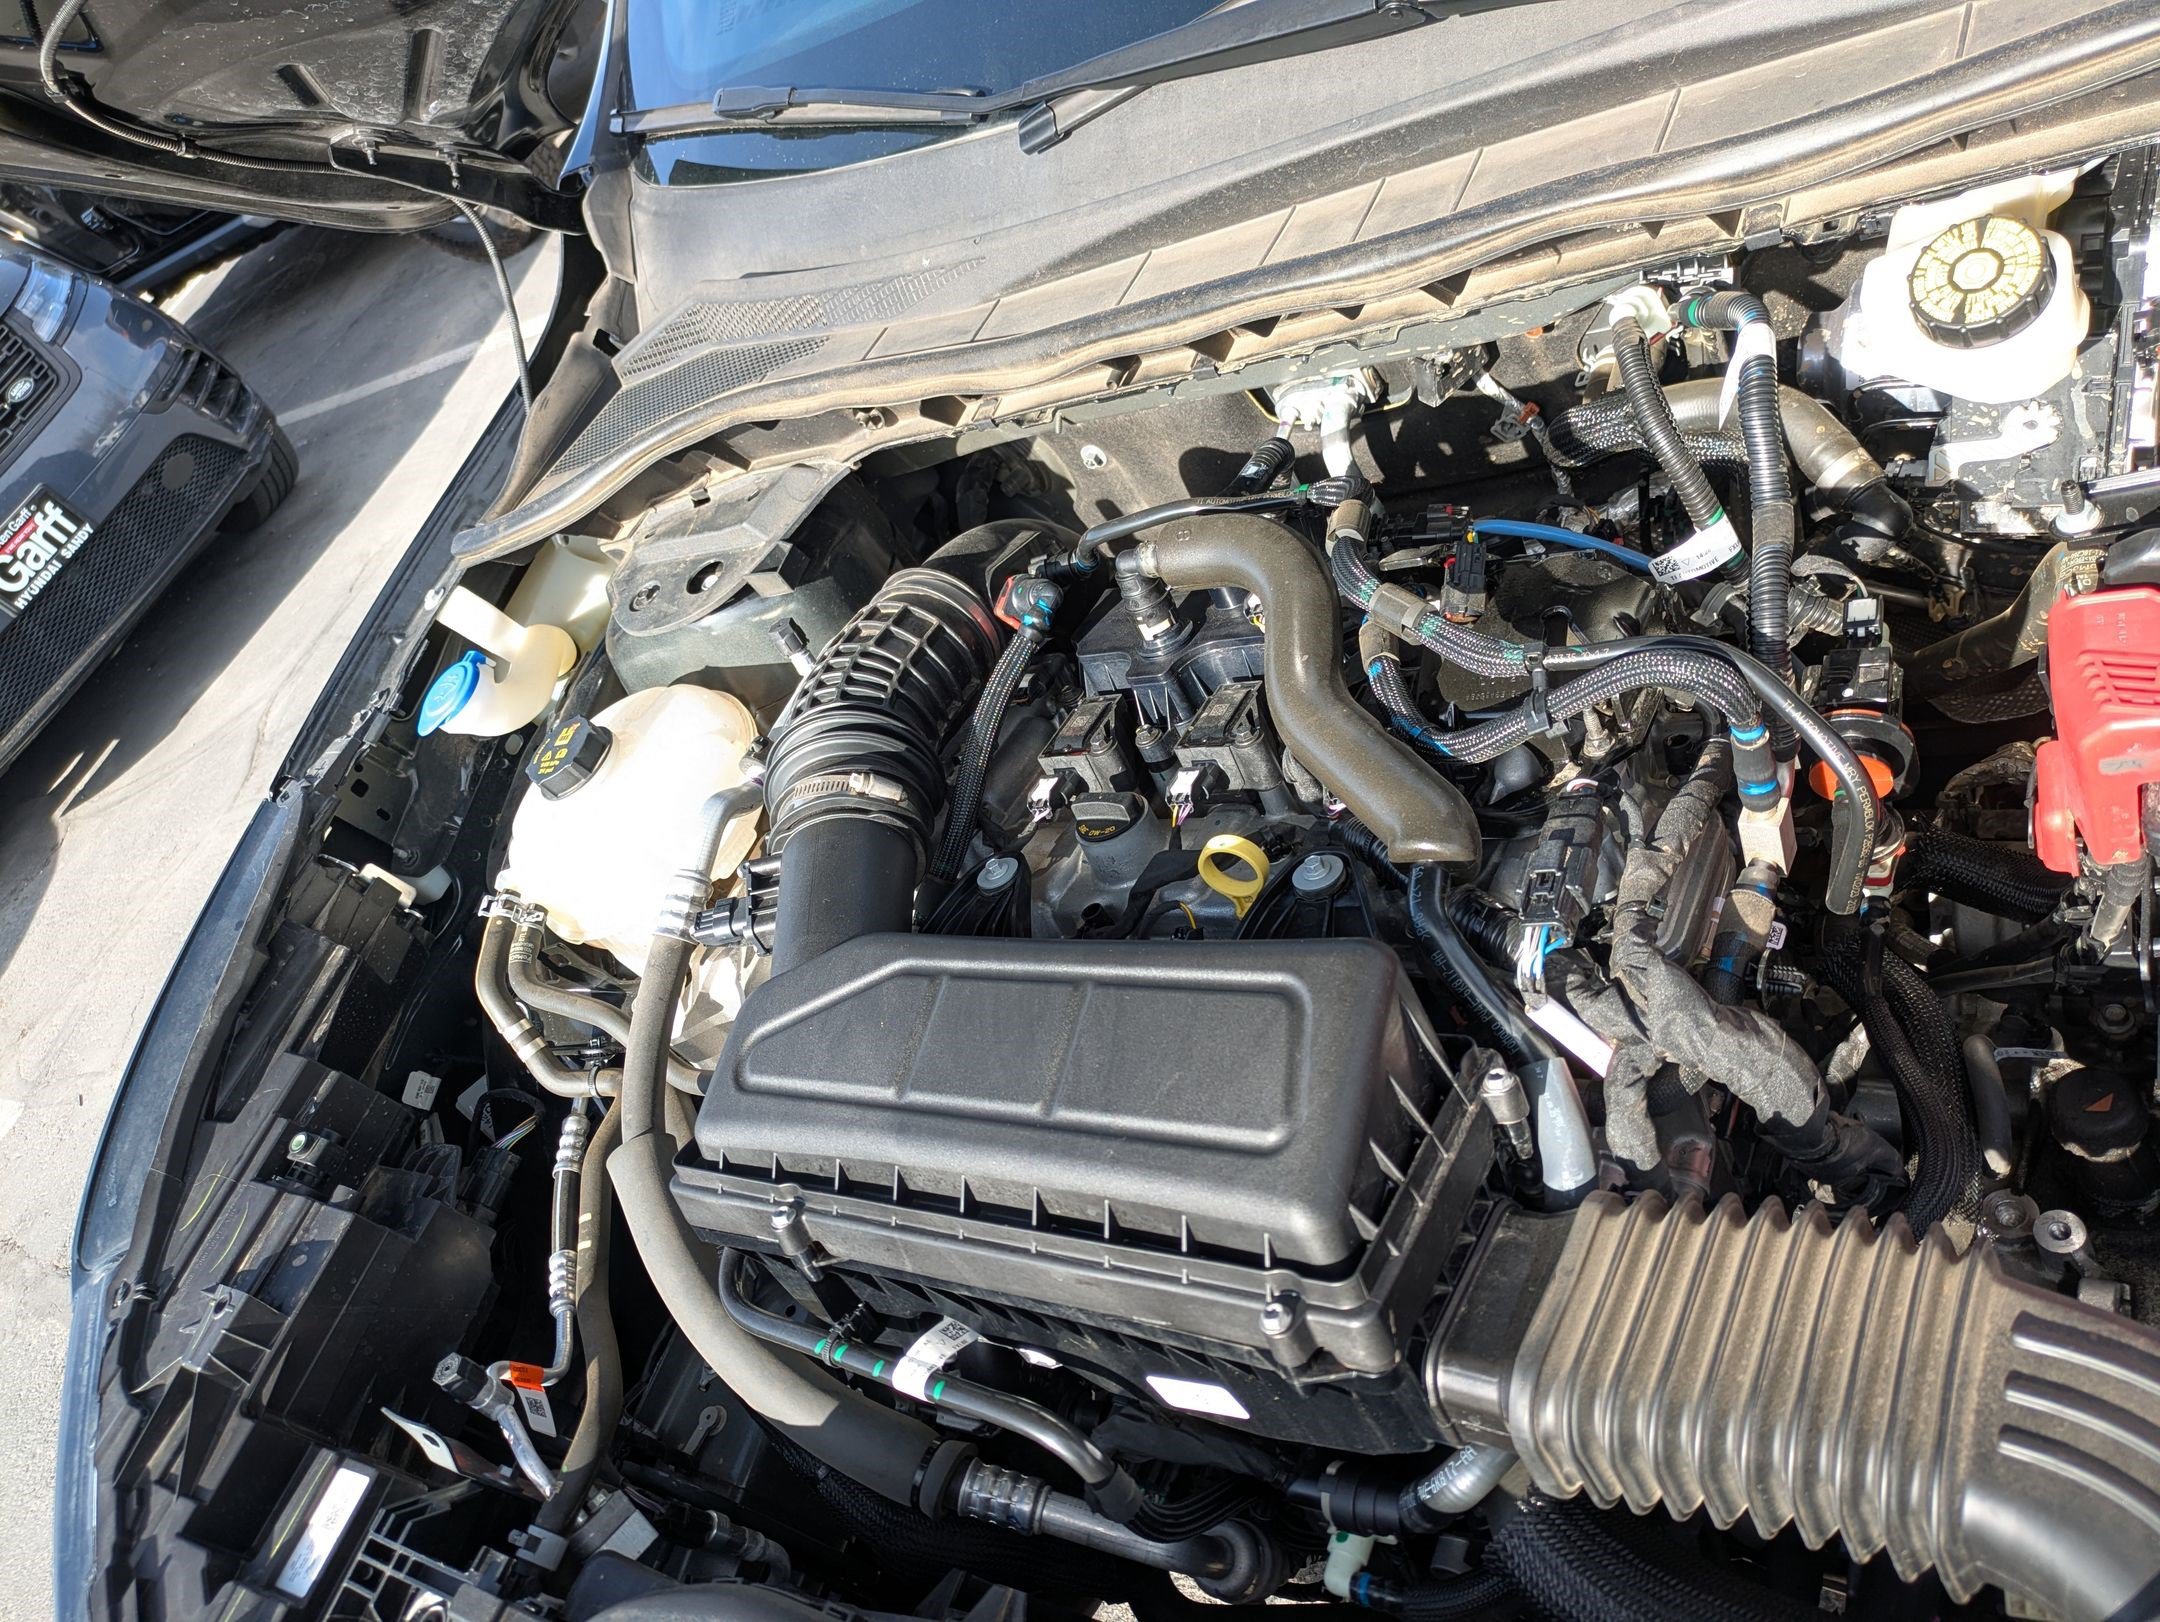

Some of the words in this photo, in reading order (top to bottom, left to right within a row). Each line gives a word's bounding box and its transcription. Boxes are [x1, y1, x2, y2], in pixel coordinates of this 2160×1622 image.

[0, 501, 78, 592] Garff
[8, 507, 32, 532] Garff
[14, 559, 63, 610] HYUNDAI
[60, 522, 94, 559] SANDY
[1792, 711, 1846, 761] AUTOMOTIVE
[1857, 785, 1876, 833] PERMBLOK
[1088, 825, 1116, 836] 0W-20
